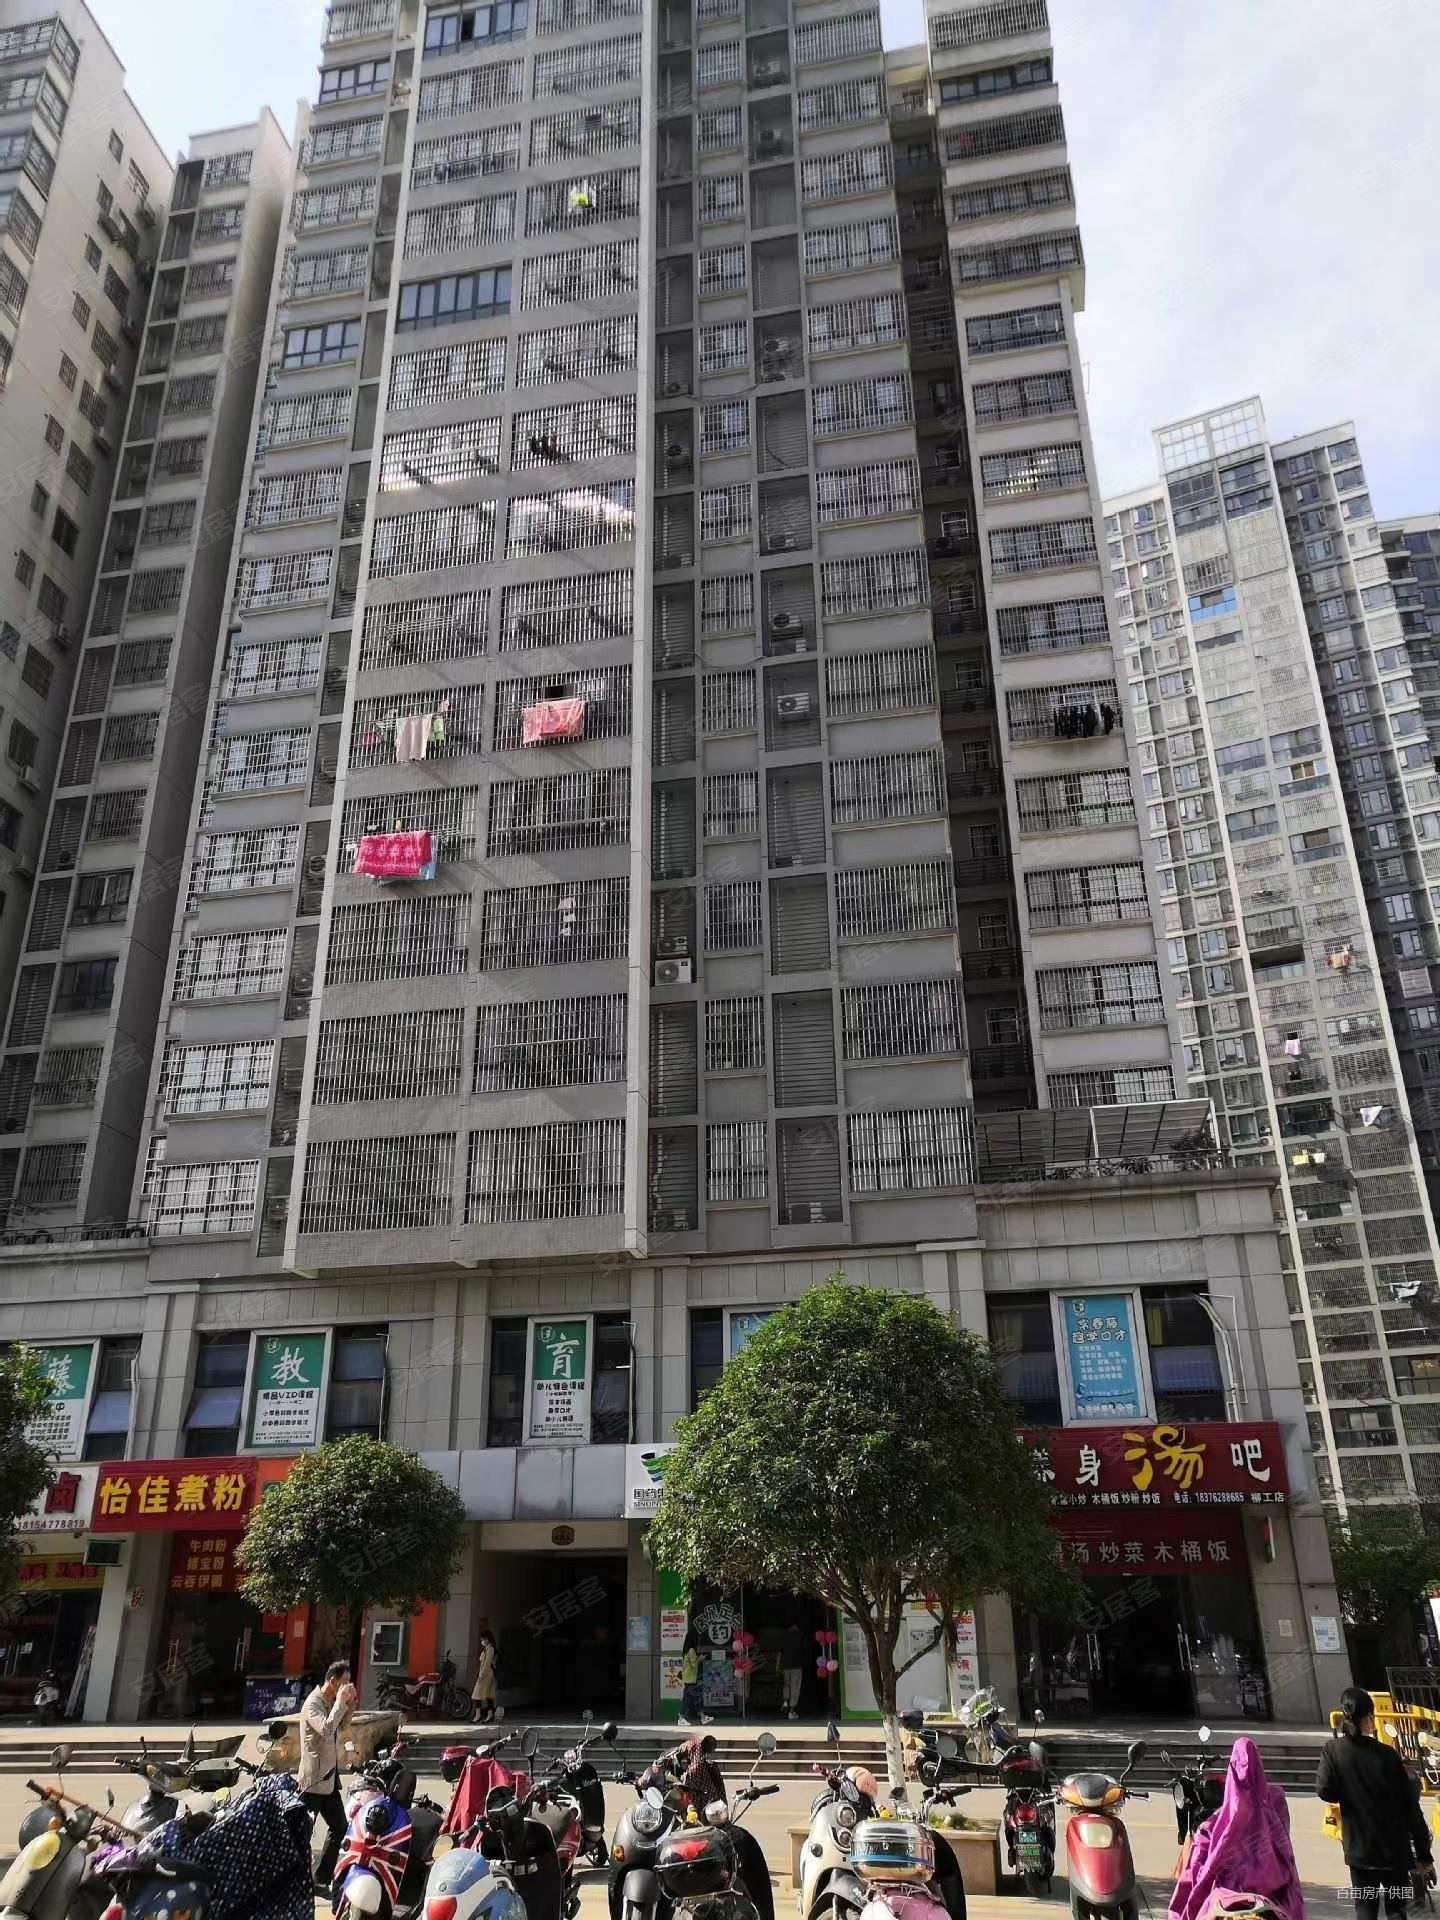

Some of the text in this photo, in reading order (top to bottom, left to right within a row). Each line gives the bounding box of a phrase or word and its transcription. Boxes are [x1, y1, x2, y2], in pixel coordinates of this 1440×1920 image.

[270, 1347, 310, 1386] 教
[546, 1332, 580, 1379] 育
[99, 1473, 246, 1515] 怡佳煮粉
[1092, 1493, 1120, 1505] 木桶饭
[1100, 1540, 1145, 1564] 炒菜
[1154, 1539, 1231, 1563] 木桶饭
